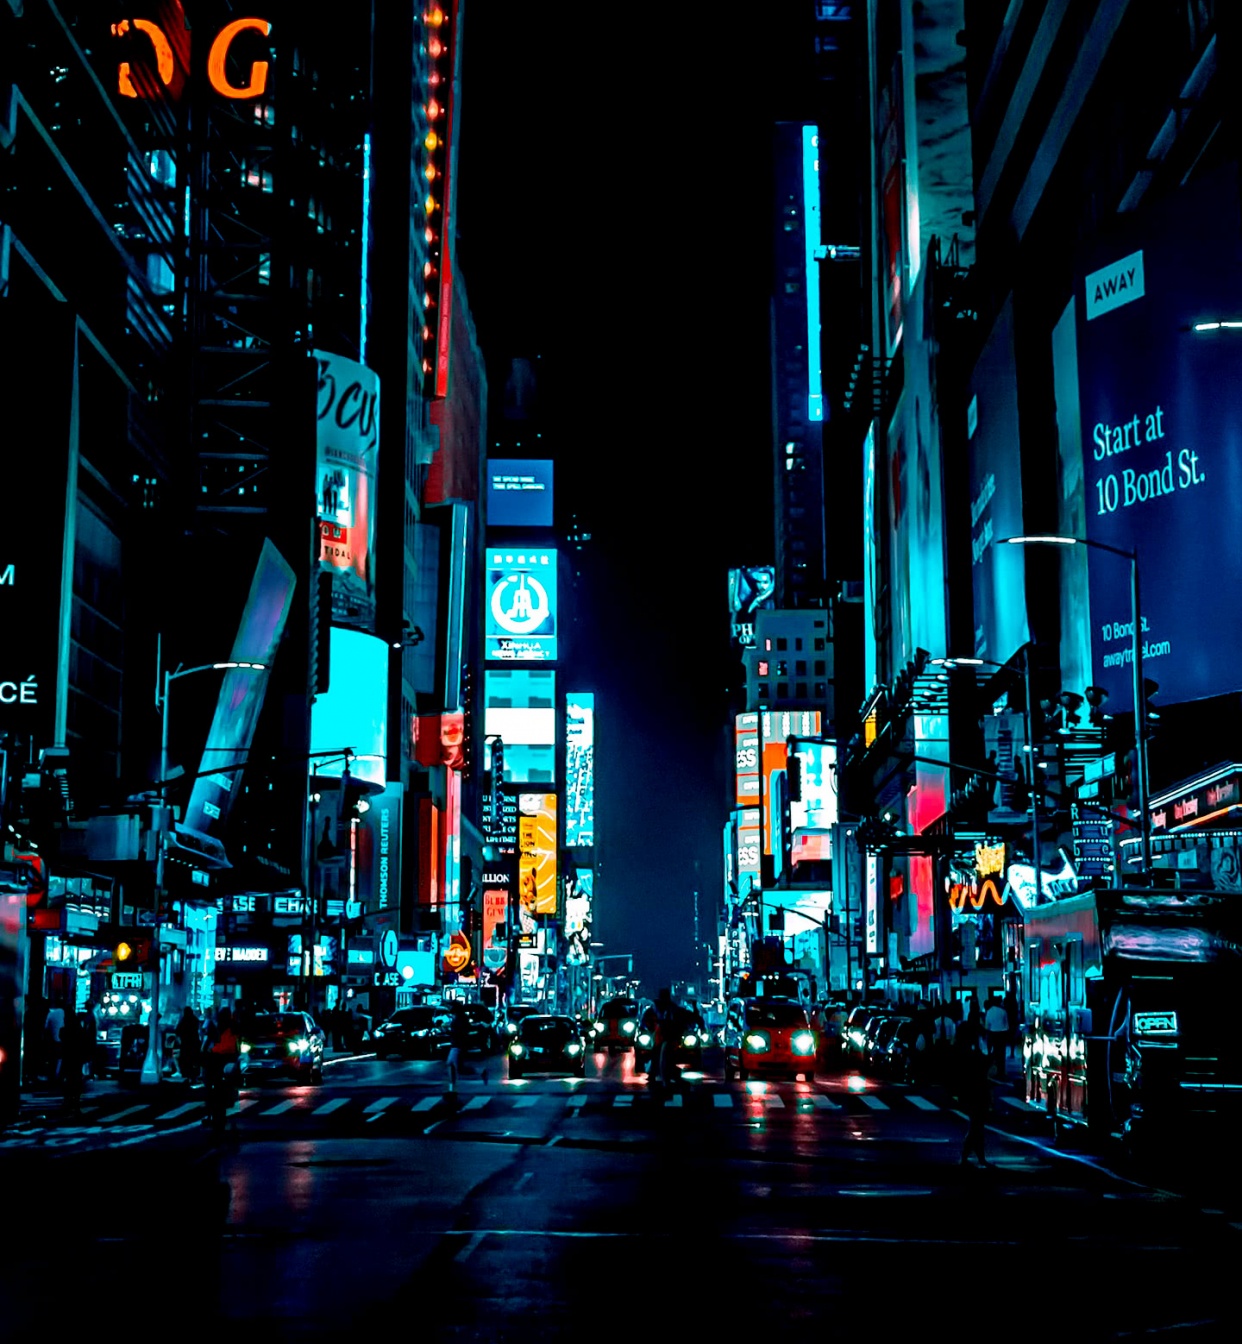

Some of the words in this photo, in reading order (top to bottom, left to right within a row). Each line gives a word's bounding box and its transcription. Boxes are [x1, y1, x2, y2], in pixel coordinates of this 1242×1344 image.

[1094, 267, 1136, 304] AWAY
[1093, 414, 1142, 461] Start
[1145, 405, 1165, 442] at
[1096, 473, 1119, 516] 10
[1122, 451, 1175, 507] Bond
[1178, 448, 1206, 490] St.
[324, 545, 351, 559] TIDAL
[1101, 623, 1112, 642] 10
[380, 807, 390, 855] REUTERS
[379, 857, 389, 909] THOMSON
[374, 972, 400, 986] CASE
